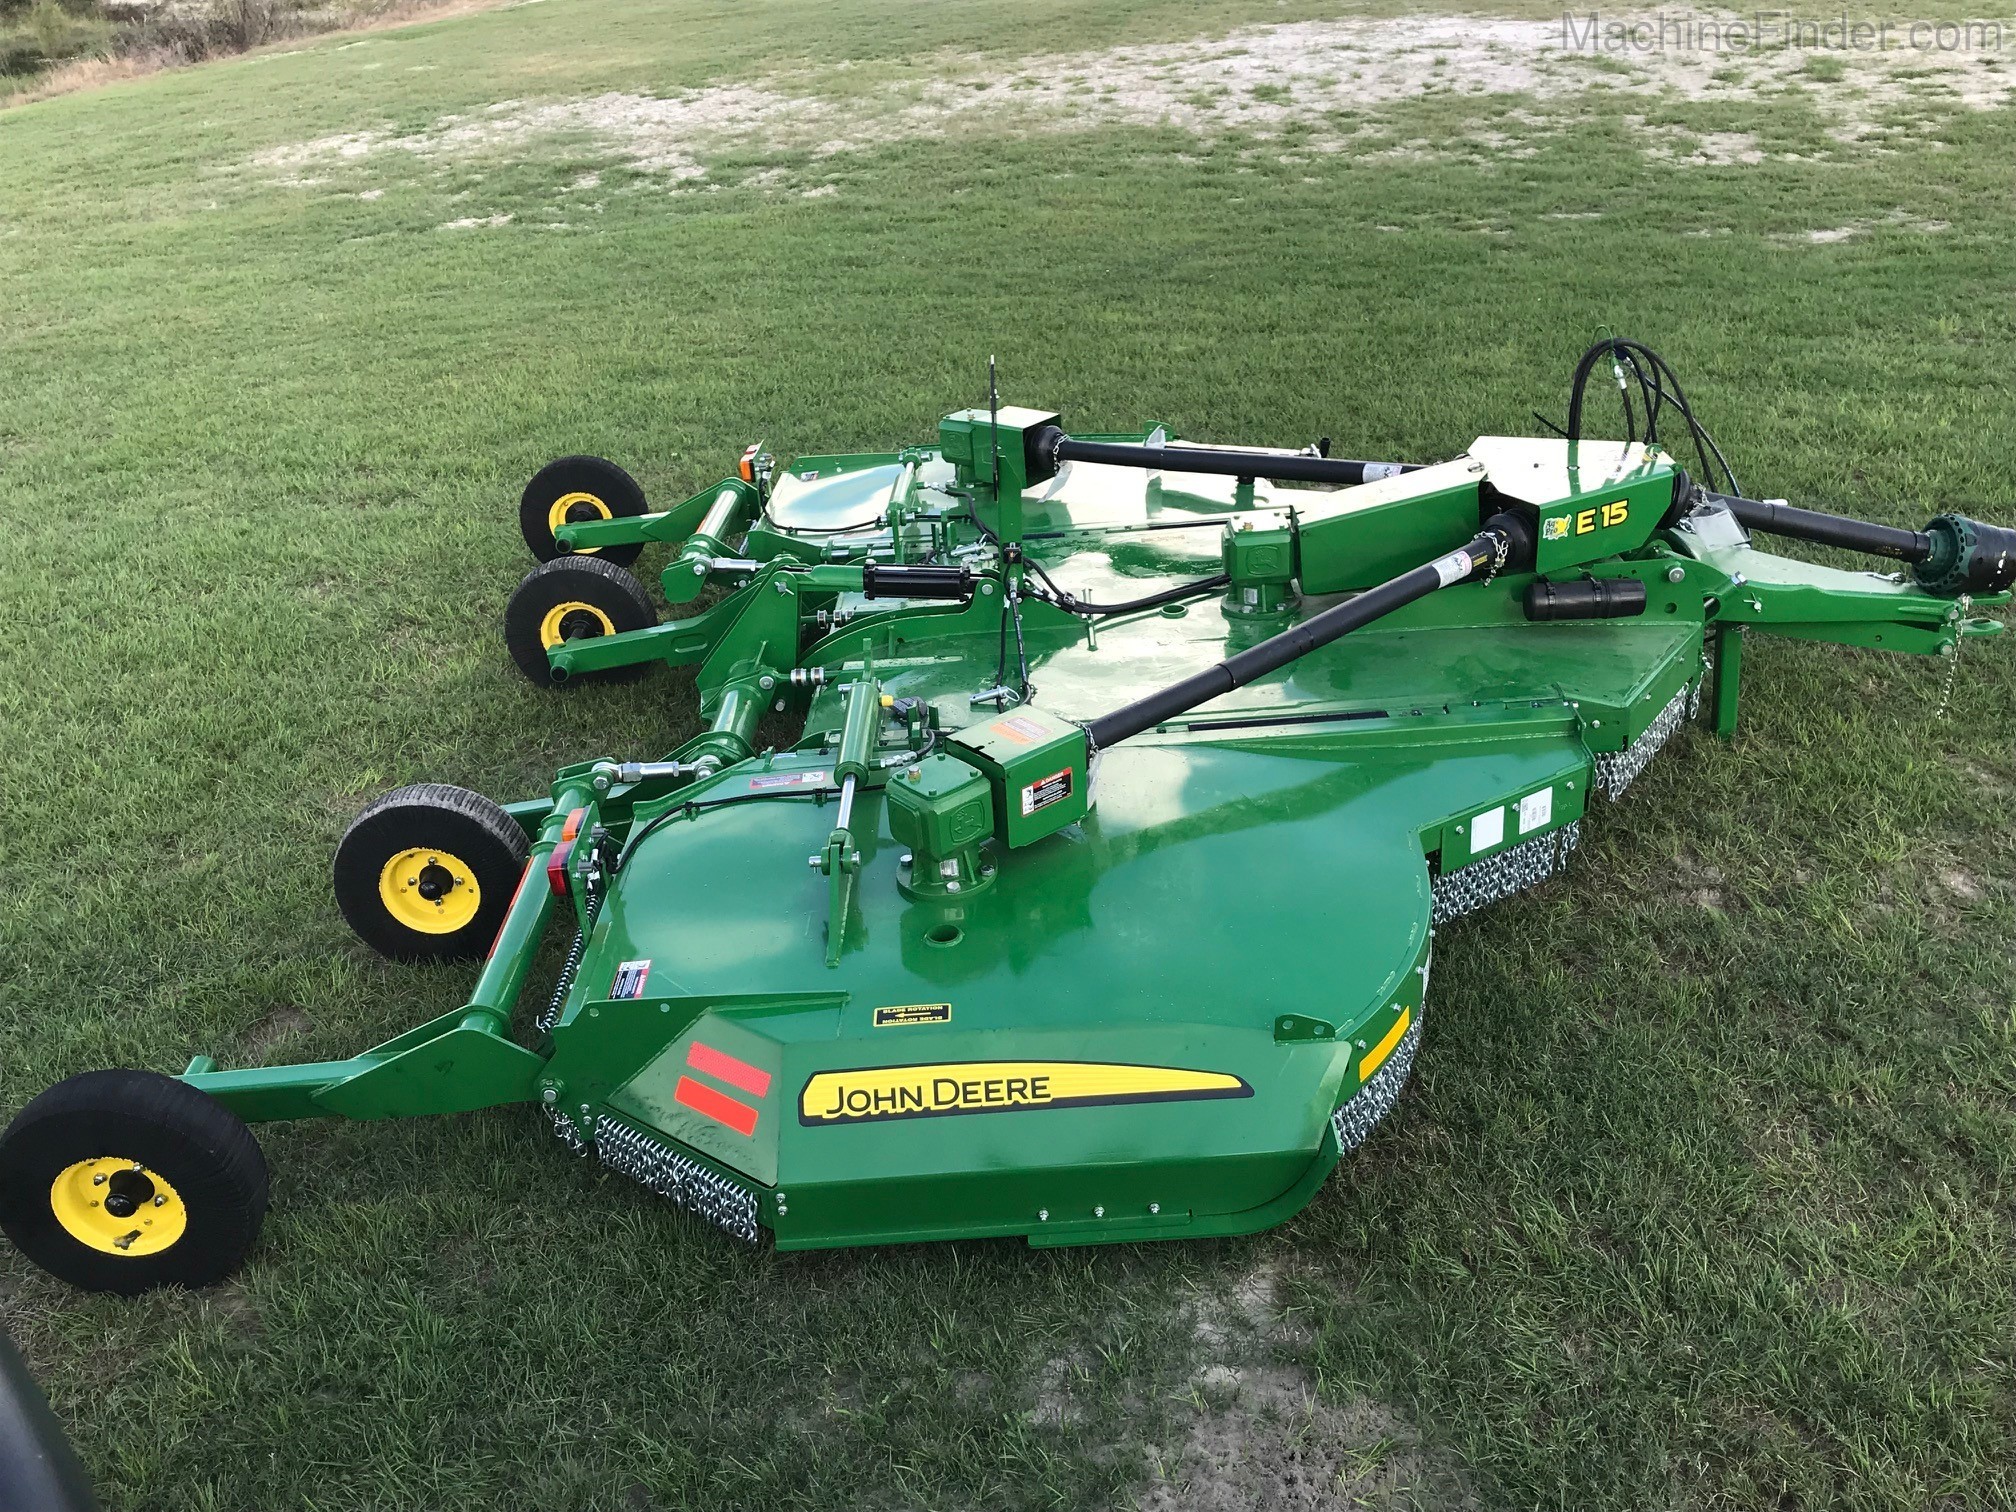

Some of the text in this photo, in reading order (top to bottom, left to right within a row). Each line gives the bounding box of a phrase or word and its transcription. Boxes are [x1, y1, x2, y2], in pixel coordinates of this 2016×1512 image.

[1575, 499, 1629, 536] E 15
[825, 1076, 1052, 1115] JOHN DEERE
